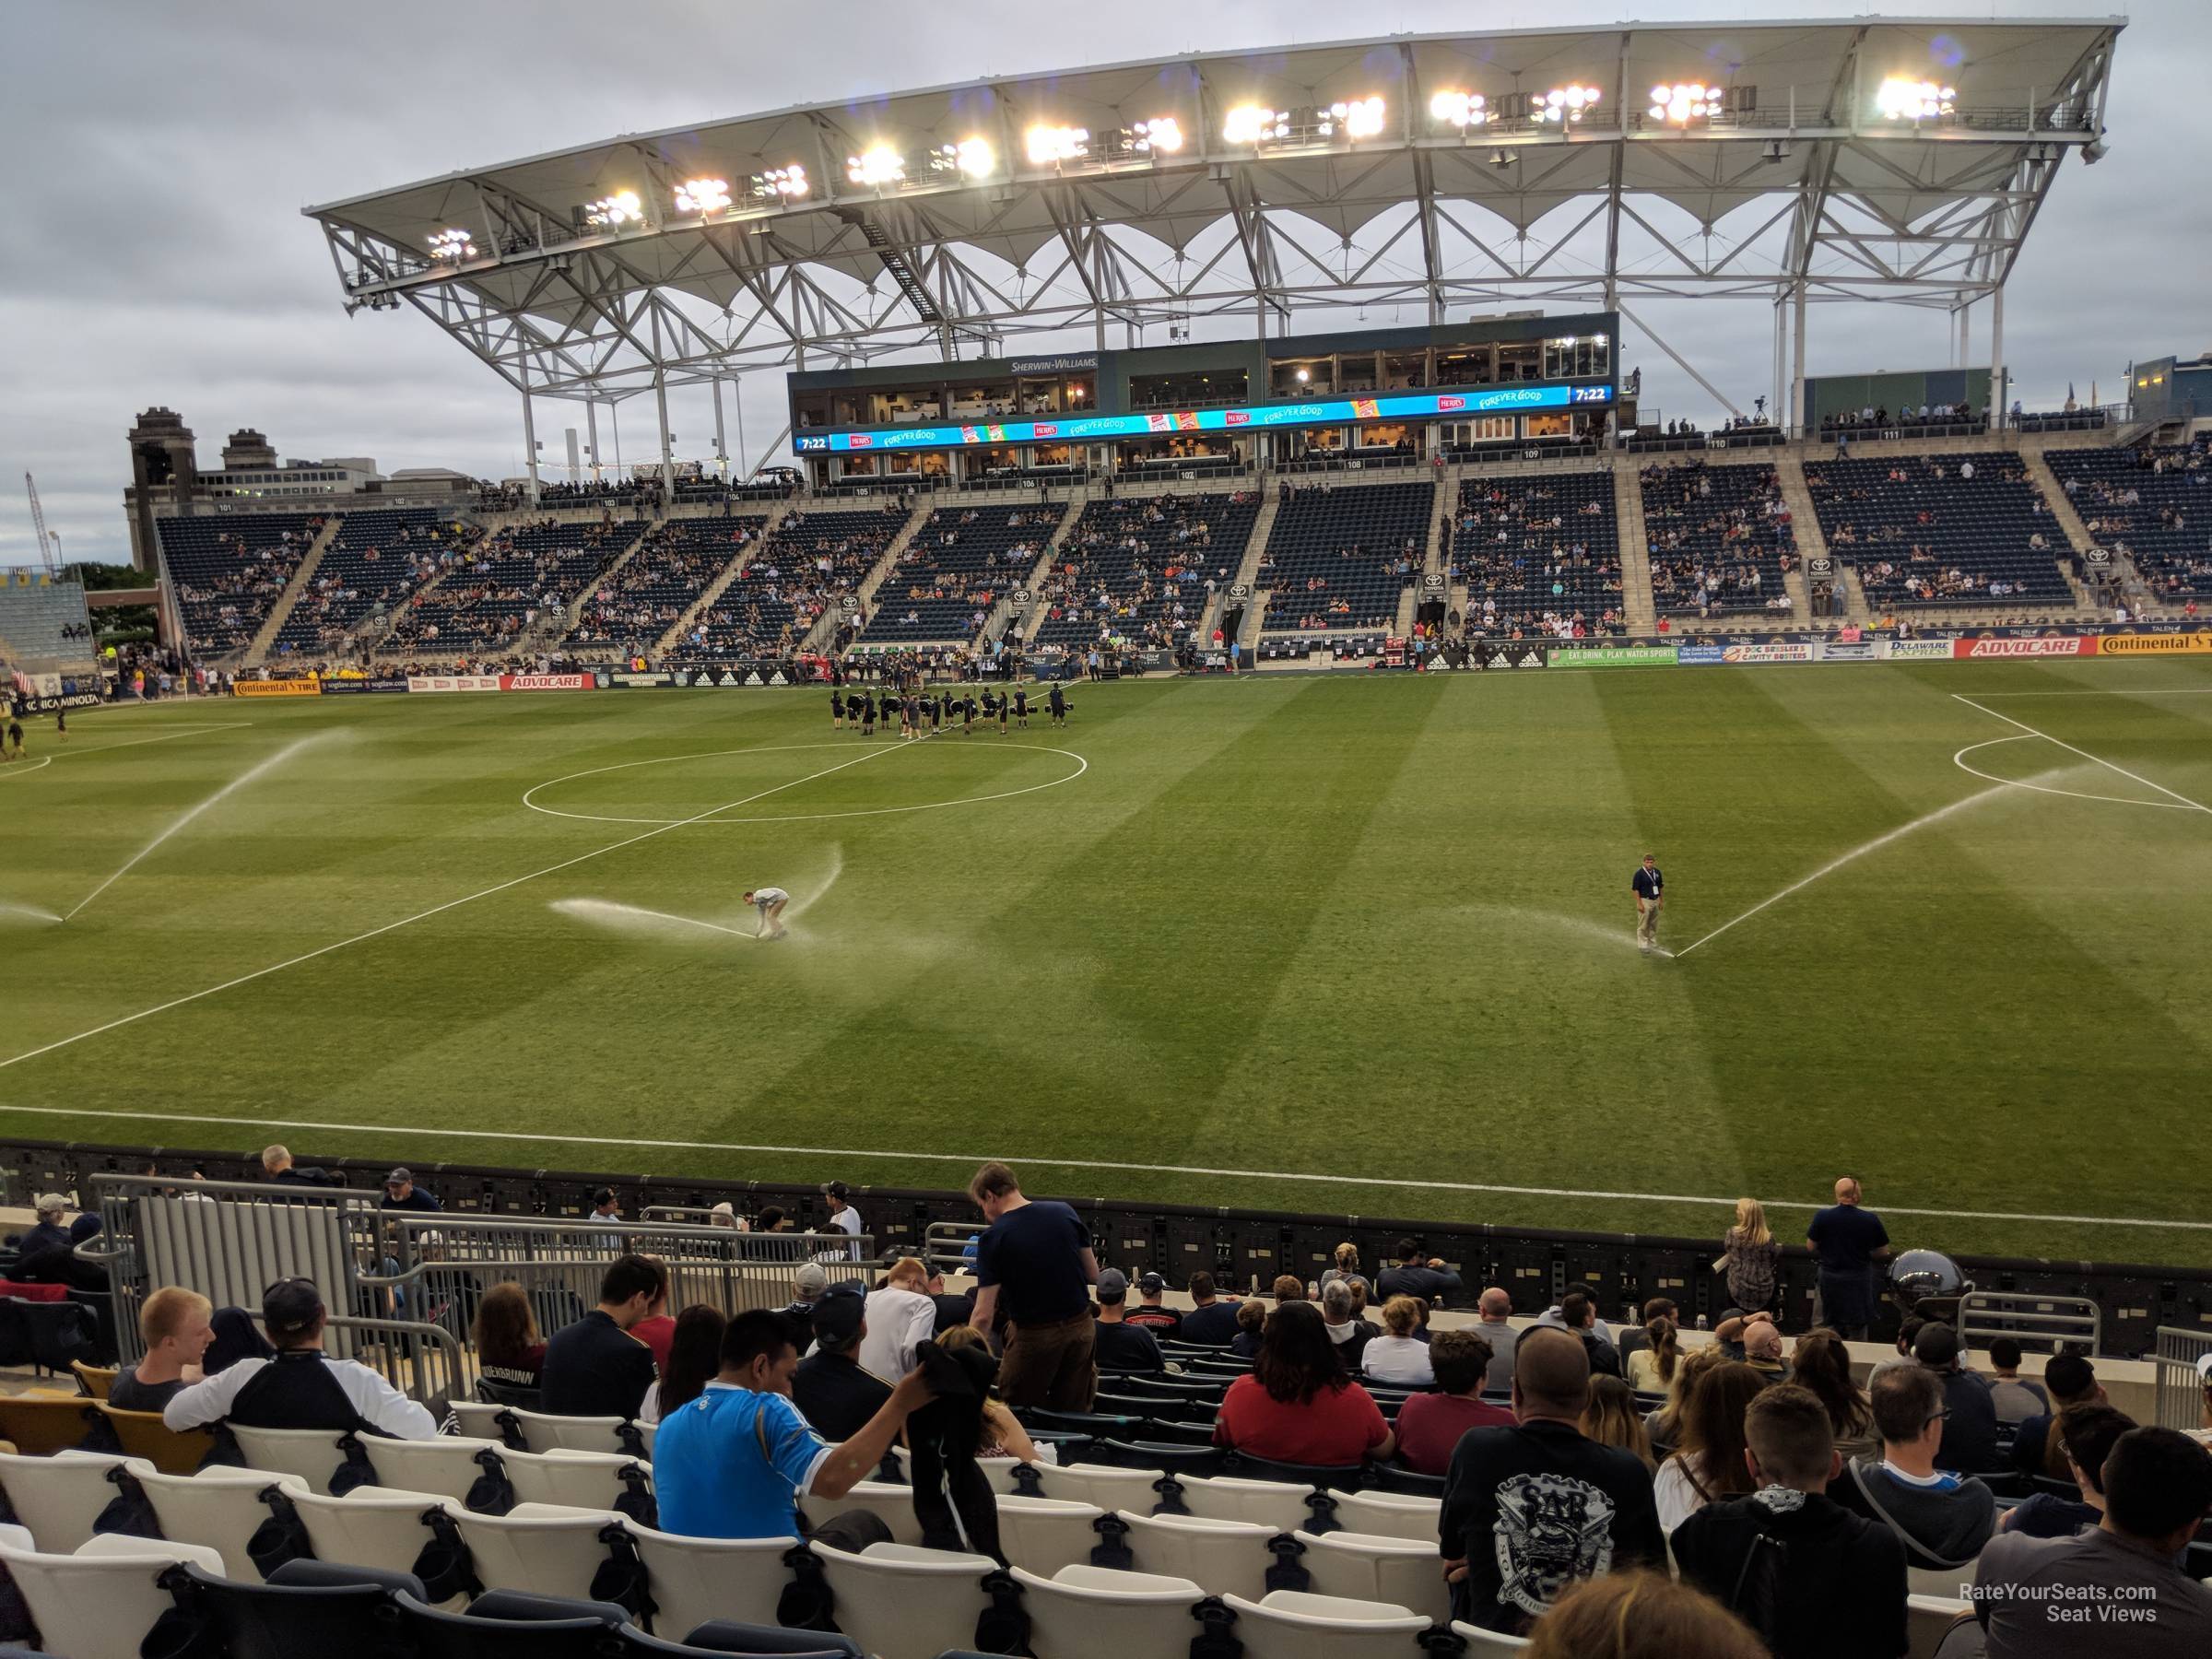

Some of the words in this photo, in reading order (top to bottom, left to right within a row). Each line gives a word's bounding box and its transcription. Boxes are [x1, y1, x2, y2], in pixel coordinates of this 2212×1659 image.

[1479, 392, 1517, 409] FOREVER
[1518, 390, 1542, 401] GOOD
[1576, 388, 1606, 401] 7:22
[1265, 406, 1298, 424] FOREVER
[1299, 406, 1323, 416] GOOD
[1070, 421, 1102, 436] FOREVER
[1103, 418, 1125, 429] GOOD
[884, 432, 915, 446] FOREVER
[915, 429, 935, 441] GOOD
[1884, 431, 1899, 440] 111
[802, 438, 826, 450] 7:22
[1711, 440, 1725, 448] 110
[1524, 450, 1539, 458] 109
[1347, 461, 1361, 469] 108
[1891, 641, 1948, 650] DELAWARE
[1972, 639, 2079, 654] ADVOCARE
[2102, 636, 2189, 653] Continental
[1626, 650, 1649, 658] WATCH
[1891, 649, 1948, 657] EXPRESS
[1519, 660, 1543, 668] adidas
[237, 682, 288, 695] Continental
[298, 683, 318, 691] TIRE
[512, 675, 582, 689] ADVOCARE
[61, 693, 99, 707] MINOLTA
[1521, 1484, 1589, 1522] SAR
